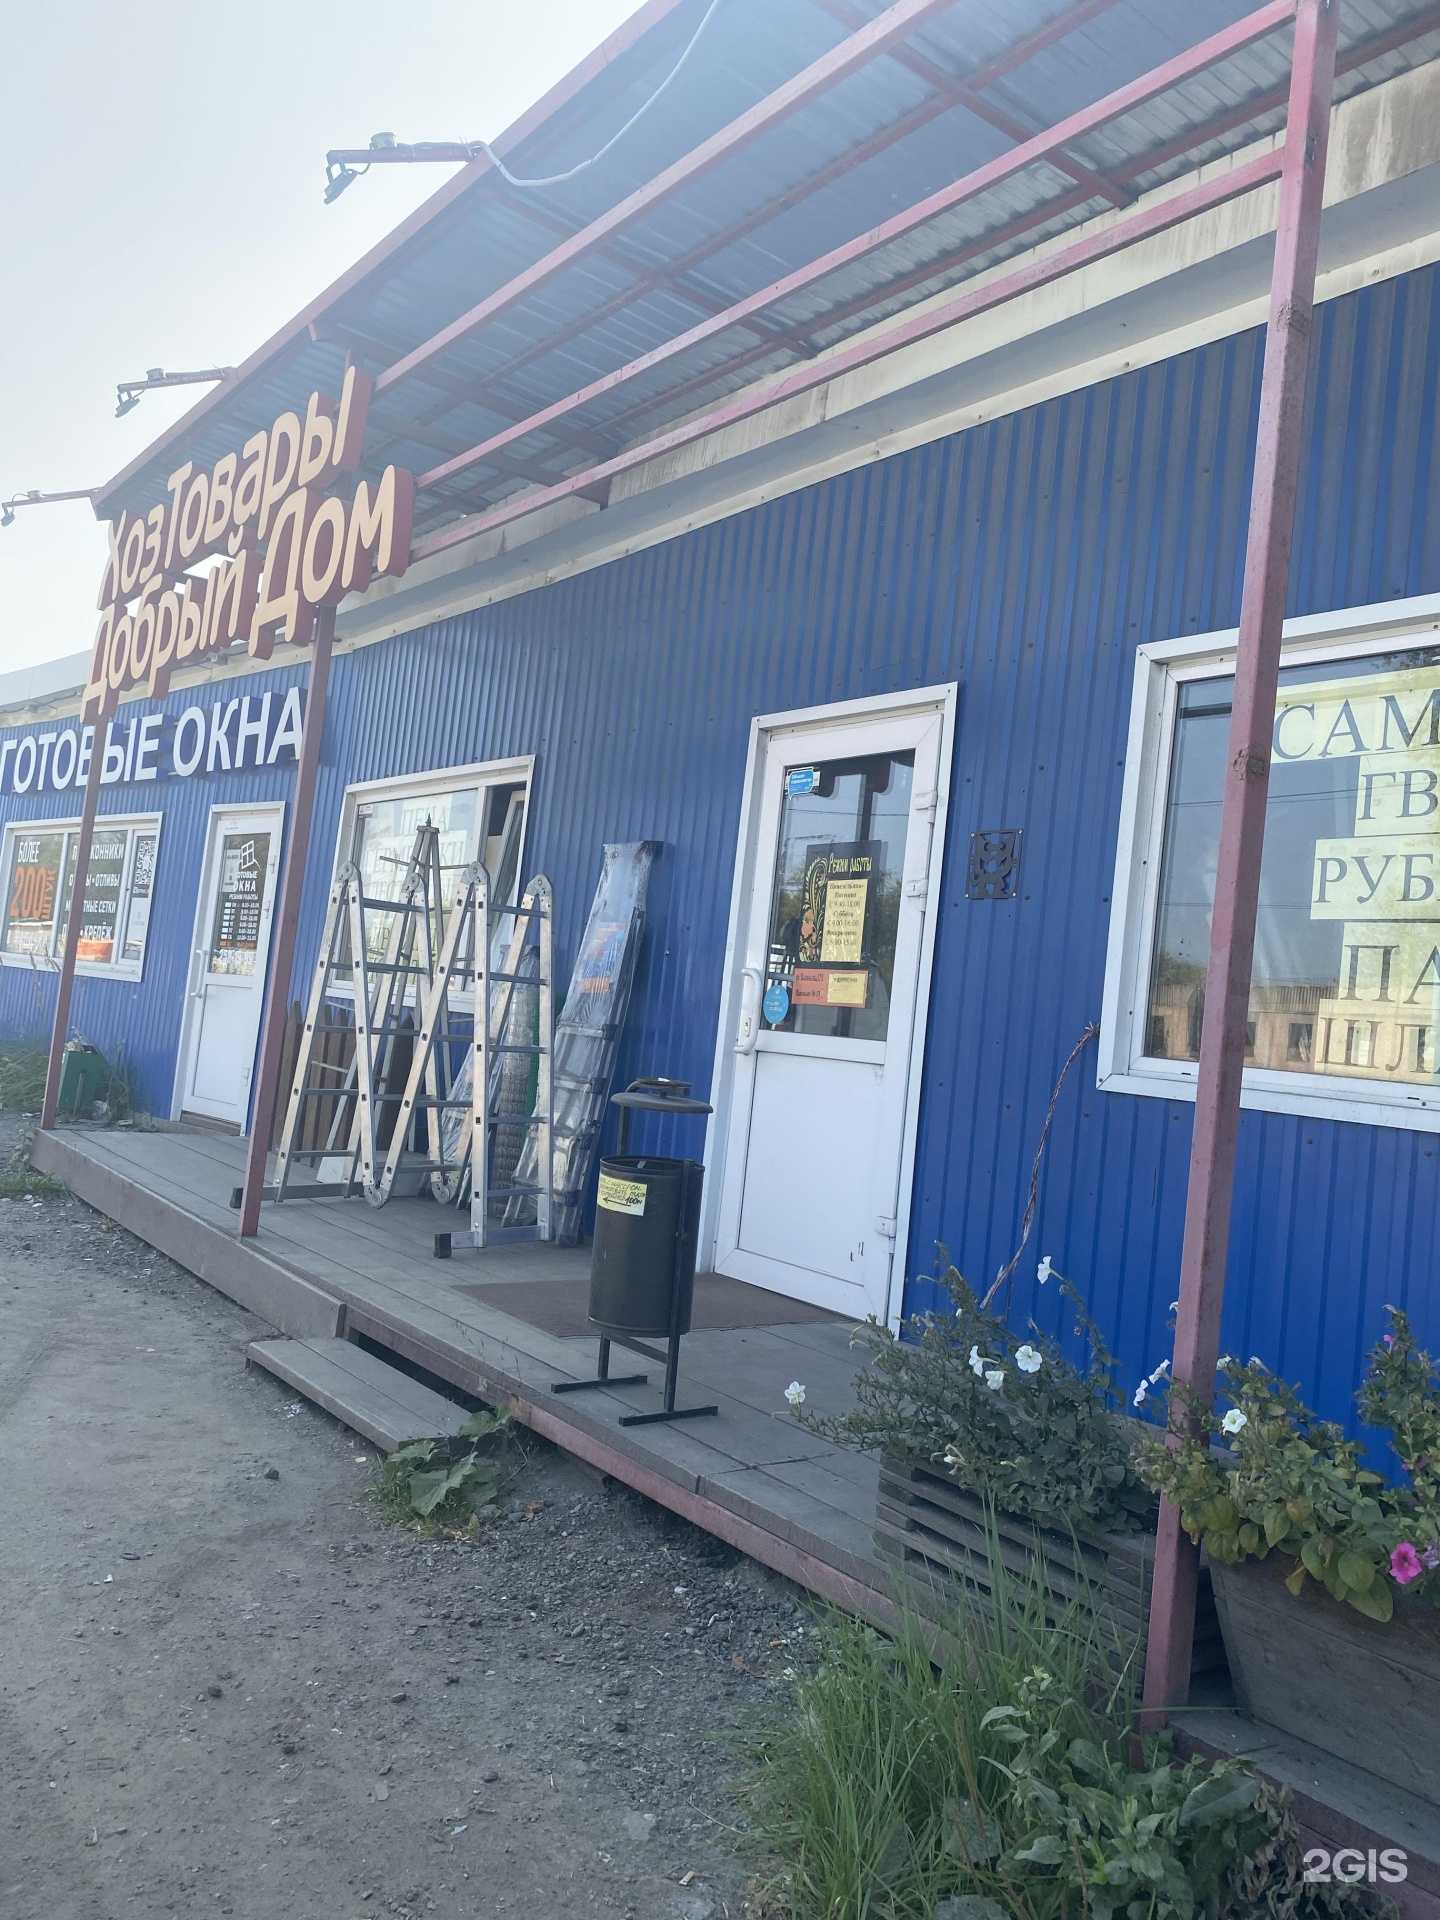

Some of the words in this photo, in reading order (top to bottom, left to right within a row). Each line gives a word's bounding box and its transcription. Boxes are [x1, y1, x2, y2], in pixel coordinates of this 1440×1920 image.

[81, 525, 248, 722] Добрый
[249, 464, 396, 657] Дом
[173, 686, 303, 777] ОКНА
[1272, 688, 1440, 760] САМ
[17, 840, 41, 863] БОЛЕЕ
[1313, 853, 1440, 905] РУБ
[10, 866, 49, 918] 200
[1316, 1017, 1440, 1075] ШЛ
